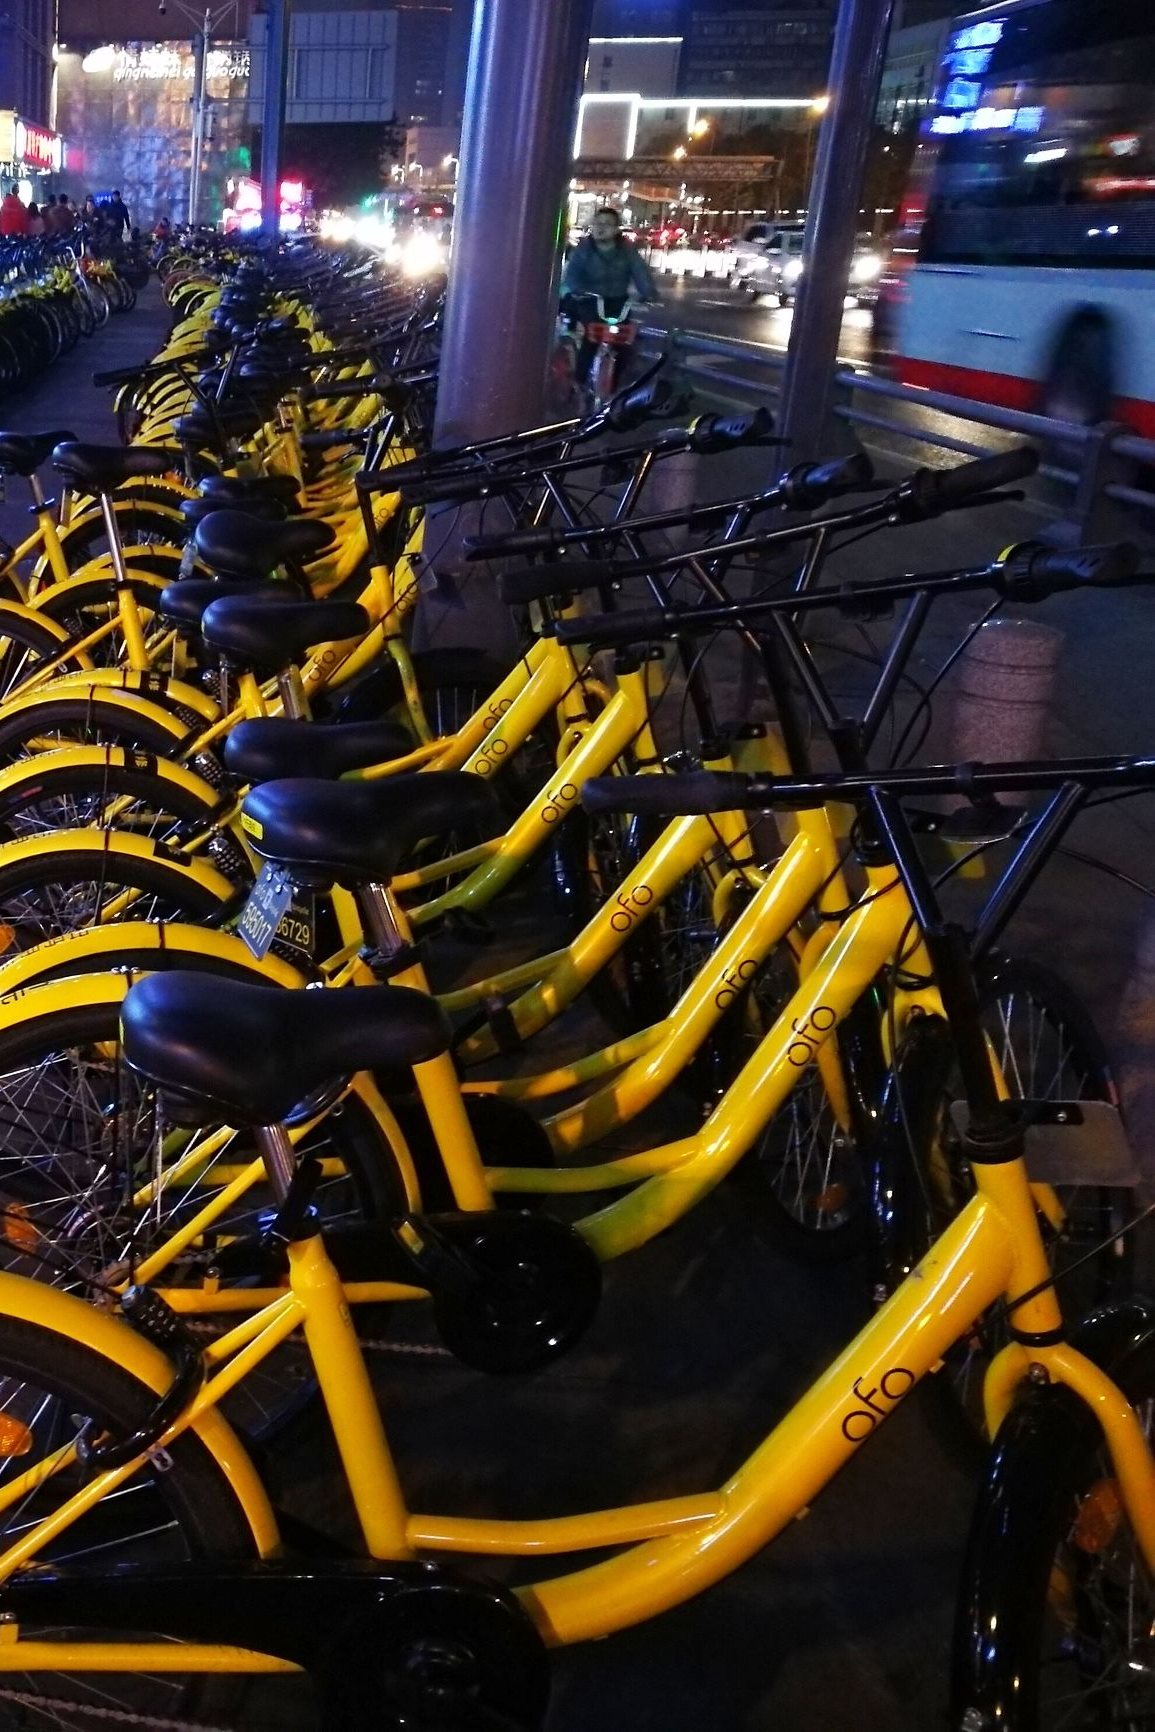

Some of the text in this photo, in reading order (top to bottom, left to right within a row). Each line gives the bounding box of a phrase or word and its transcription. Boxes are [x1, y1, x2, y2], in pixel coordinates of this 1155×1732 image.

[309, 650, 335, 681] ofo
[475, 738, 508, 775] ofo
[540, 782, 578, 824] ofo
[610, 884, 654, 933] ofo
[714, 959, 758, 1011] ofo
[787, 1005, 837, 1067] ofo
[842, 1367, 915, 1442] ofo
